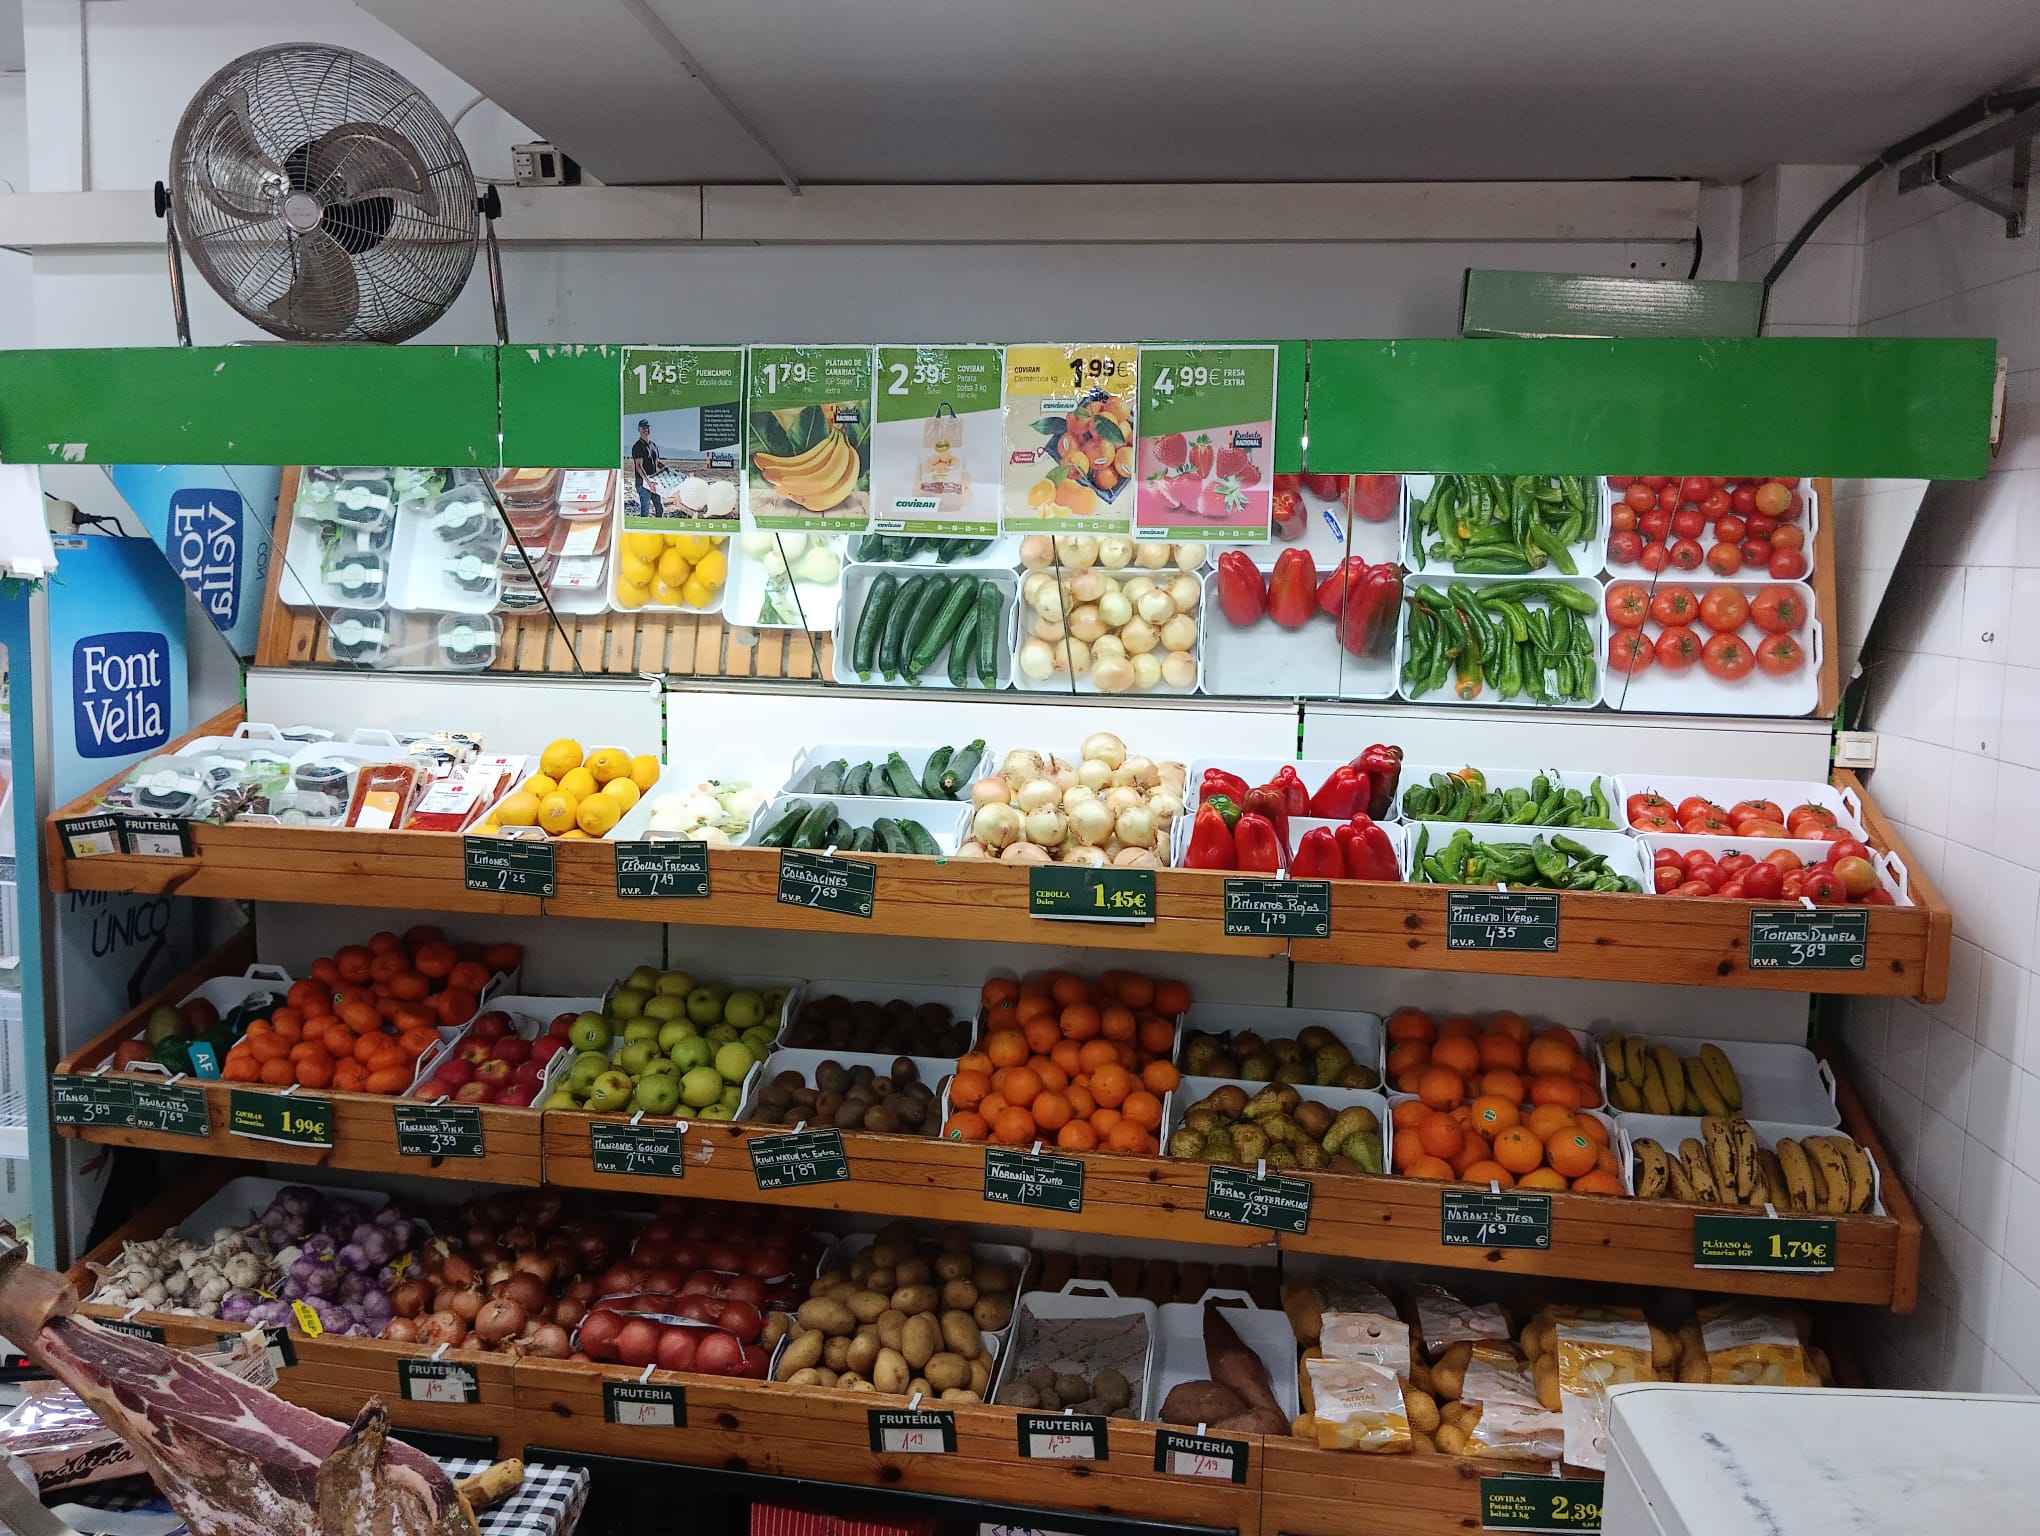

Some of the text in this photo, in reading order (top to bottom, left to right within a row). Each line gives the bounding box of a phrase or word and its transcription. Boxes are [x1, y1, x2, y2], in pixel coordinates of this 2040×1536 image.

[853, 359, 862, 367] DE
[696, 369, 732, 377] FUENCAMPO
[825, 368, 856, 376] CANARIAS
[957, 365, 985, 373] COVIRAN
[1014, 366, 1041, 374] COVIRAN
[1223, 369, 1246, 377] FRESA
[1050, 375, 1058, 384] kg
[1223, 379, 1246, 387] EXTRA
[956, 384, 973, 392] bolsa
[979, 383, 987, 393] kg
[83, 646, 161, 694] Font
[82, 690, 165, 746] Vella
[65, 817, 117, 832] FRUTERÍA
[125, 820, 179, 831] FRUTERÍA
[468, 880, 489, 888] P.V.P.
[620, 887, 642, 895] P.V.P.
[1036, 890, 1070, 898] CEBOLLA
[1093, 883, 1146, 908] 1,45€
[781, 892, 802, 902] P.V.P.
[1507, 911, 1540, 924] VERDE
[91, 897, 171, 958] ÚNICO
[1228, 924, 1252, 933] P.V.P.
[1451, 938, 1476, 946] P.V.P.
[1753, 958, 1779, 966] P.V.P.
[56, 1115, 76, 1123] P.V.P.
[137, 1119, 156, 1128] P.V.P.
[281, 1110, 325, 1135] 1,99€
[597, 1162, 617, 1170] P.V.P.
[761, 1178, 782, 1187] P.V.P.
[988, 1191, 1009, 1200] P.V.P.
[1209, 1209, 1232, 1220] P.V.P.
[1445, 1234, 1470, 1243] P.V.P.
[1702, 1239, 1741, 1249] PLÁTANO
[1768, 1233, 1827, 1260] 1,79€
[1702, 1249, 1753, 1257] Canarias IGP
[613, 1387, 673, 1400] FRUTERÍA
[879, 1412, 942, 1425] FRUTERÍA
[1029, 1419, 1094, 1432] FRUTERÍA
[1167, 1436, 1234, 1455] FRUTERÍA
[1489, 1494, 1526, 1503] COVIRAN
